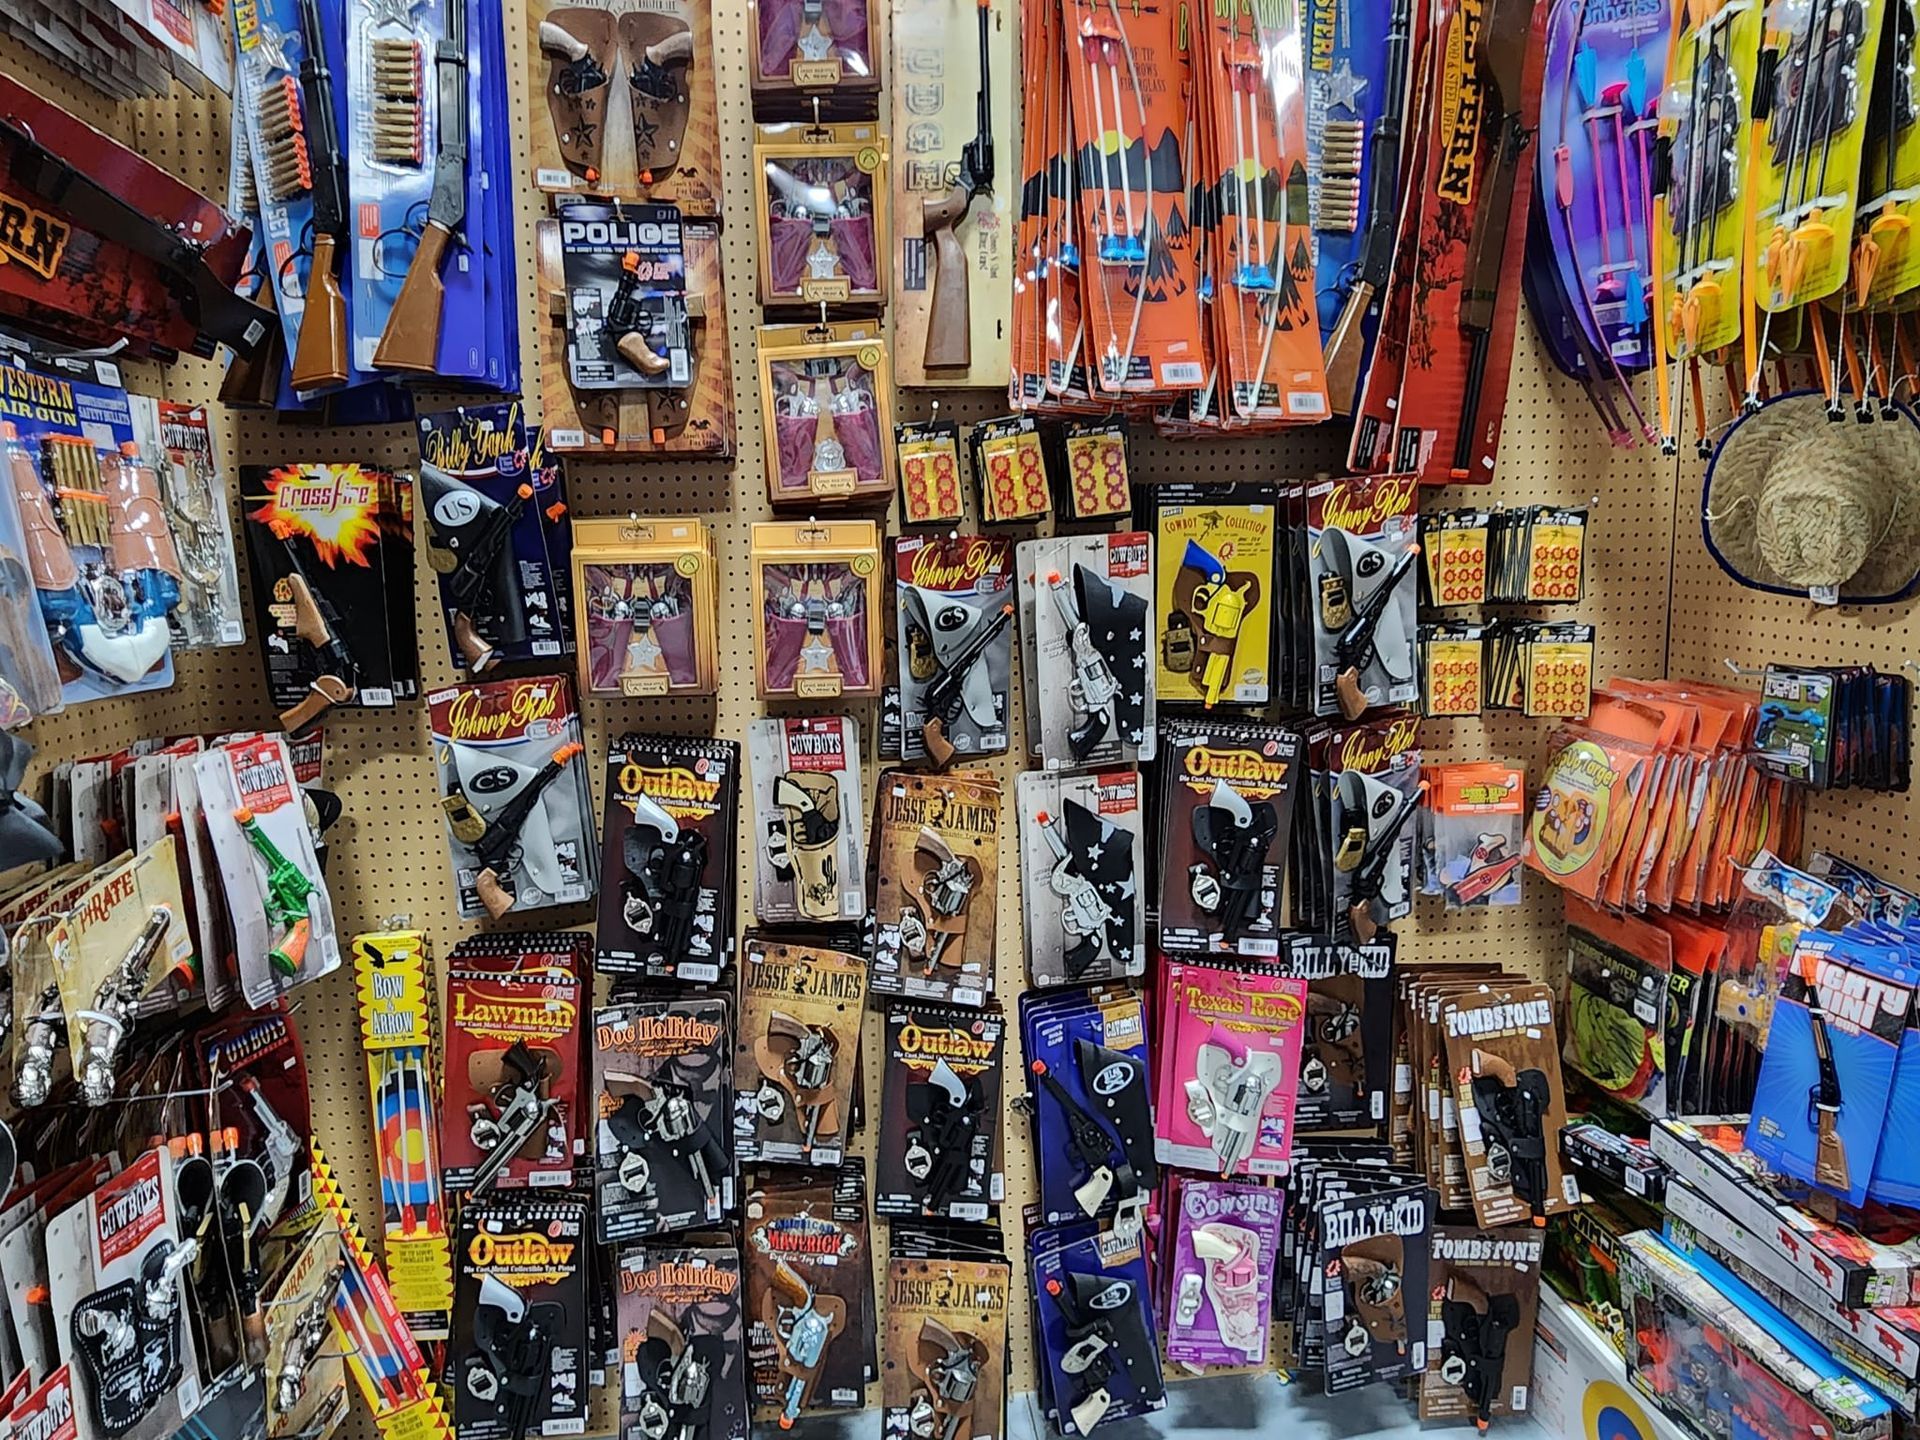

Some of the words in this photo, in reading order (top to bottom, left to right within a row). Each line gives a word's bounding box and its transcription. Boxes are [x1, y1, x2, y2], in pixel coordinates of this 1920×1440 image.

[1448, 27, 1459, 59] WOOD
[1120, 77, 1167, 92] FIBRGLASS
[1441, 0, 1482, 201] ESTERN
[1445, 73, 1457, 105] STEEL
[904, 48, 944, 192] UDGE
[267, 206, 290, 239] SET
[563, 222, 680, 245] POLICE
[40, 408, 78, 427] GUN
[161, 424, 208, 451] COWBOYS
[425, 427, 473, 475] Billy
[470, 403, 518, 463] Yank
[280, 474, 370, 513] Crossfire
[450, 496, 473, 521] US
[1322, 484, 1373, 534] Johnny
[1373, 476, 1417, 523] Reb
[1164, 517, 1197, 534] COWBOY
[1225, 515, 1267, 536] COLLECTION
[911, 541, 965, 589] Johnny
[1110, 545, 1147, 564] COWBOYS
[1358, 555, 1381, 574] CS
[938, 607, 964, 628] CS
[449, 689, 511, 742] Johnny
[511, 681, 560, 727] Reb
[790, 733, 841, 755] COWBOYS
[1341, 729, 1386, 772] Johnny
[1384, 716, 1419, 761] Reb
[239, 762, 285, 795] COWBOYS
[1184, 745, 1288, 782] Outlaw
[475, 770, 511, 790] CS
[618, 765, 720, 801] Outlaw
[886, 797, 926, 825] JESSE
[946, 803, 998, 834] JAMES
[1375, 794, 1393, 815] CS
[80, 871, 133, 934] PIRATE
[1292, 947, 1353, 981] BILLY
[1359, 946, 1391, 978] KID
[373, 973, 404, 999] BOW
[747, 963, 790, 991] JESSE
[809, 970, 862, 999] JAMES
[454, 993, 572, 1027] Lawman
[1186, 987, 1244, 1014] Texas
[1251, 995, 1301, 1021] Rose
[1448, 1000, 1551, 1038] TOMBSTONE
[373, 1009, 414, 1035] ARROW
[597, 1025, 635, 1051] Doc
[639, 1016, 719, 1046] Holliday
[1106, 1015, 1140, 1038] CAVY
[898, 1024, 996, 1058] Outlaw
[936, 1054, 966, 1063] Clectible
[100, 1175, 160, 1241] COWBOYS
[1184, 1191, 1278, 1218] COWGIRL
[775, 1217, 835, 1233] AMERICAN
[1324, 1204, 1387, 1249] BILLY
[1393, 1196, 1424, 1235] KID
[468, 1233, 575, 1265] Outlaw
[768, 1229, 841, 1254] MAVERICK
[1432, 1239, 1541, 1261] TOMBSTONE
[621, 1270, 656, 1294] Doc
[660, 1263, 737, 1292] Holliday
[890, 1280, 931, 1306] JESSE
[14, 1392, 72, 1440] OWBOYS
